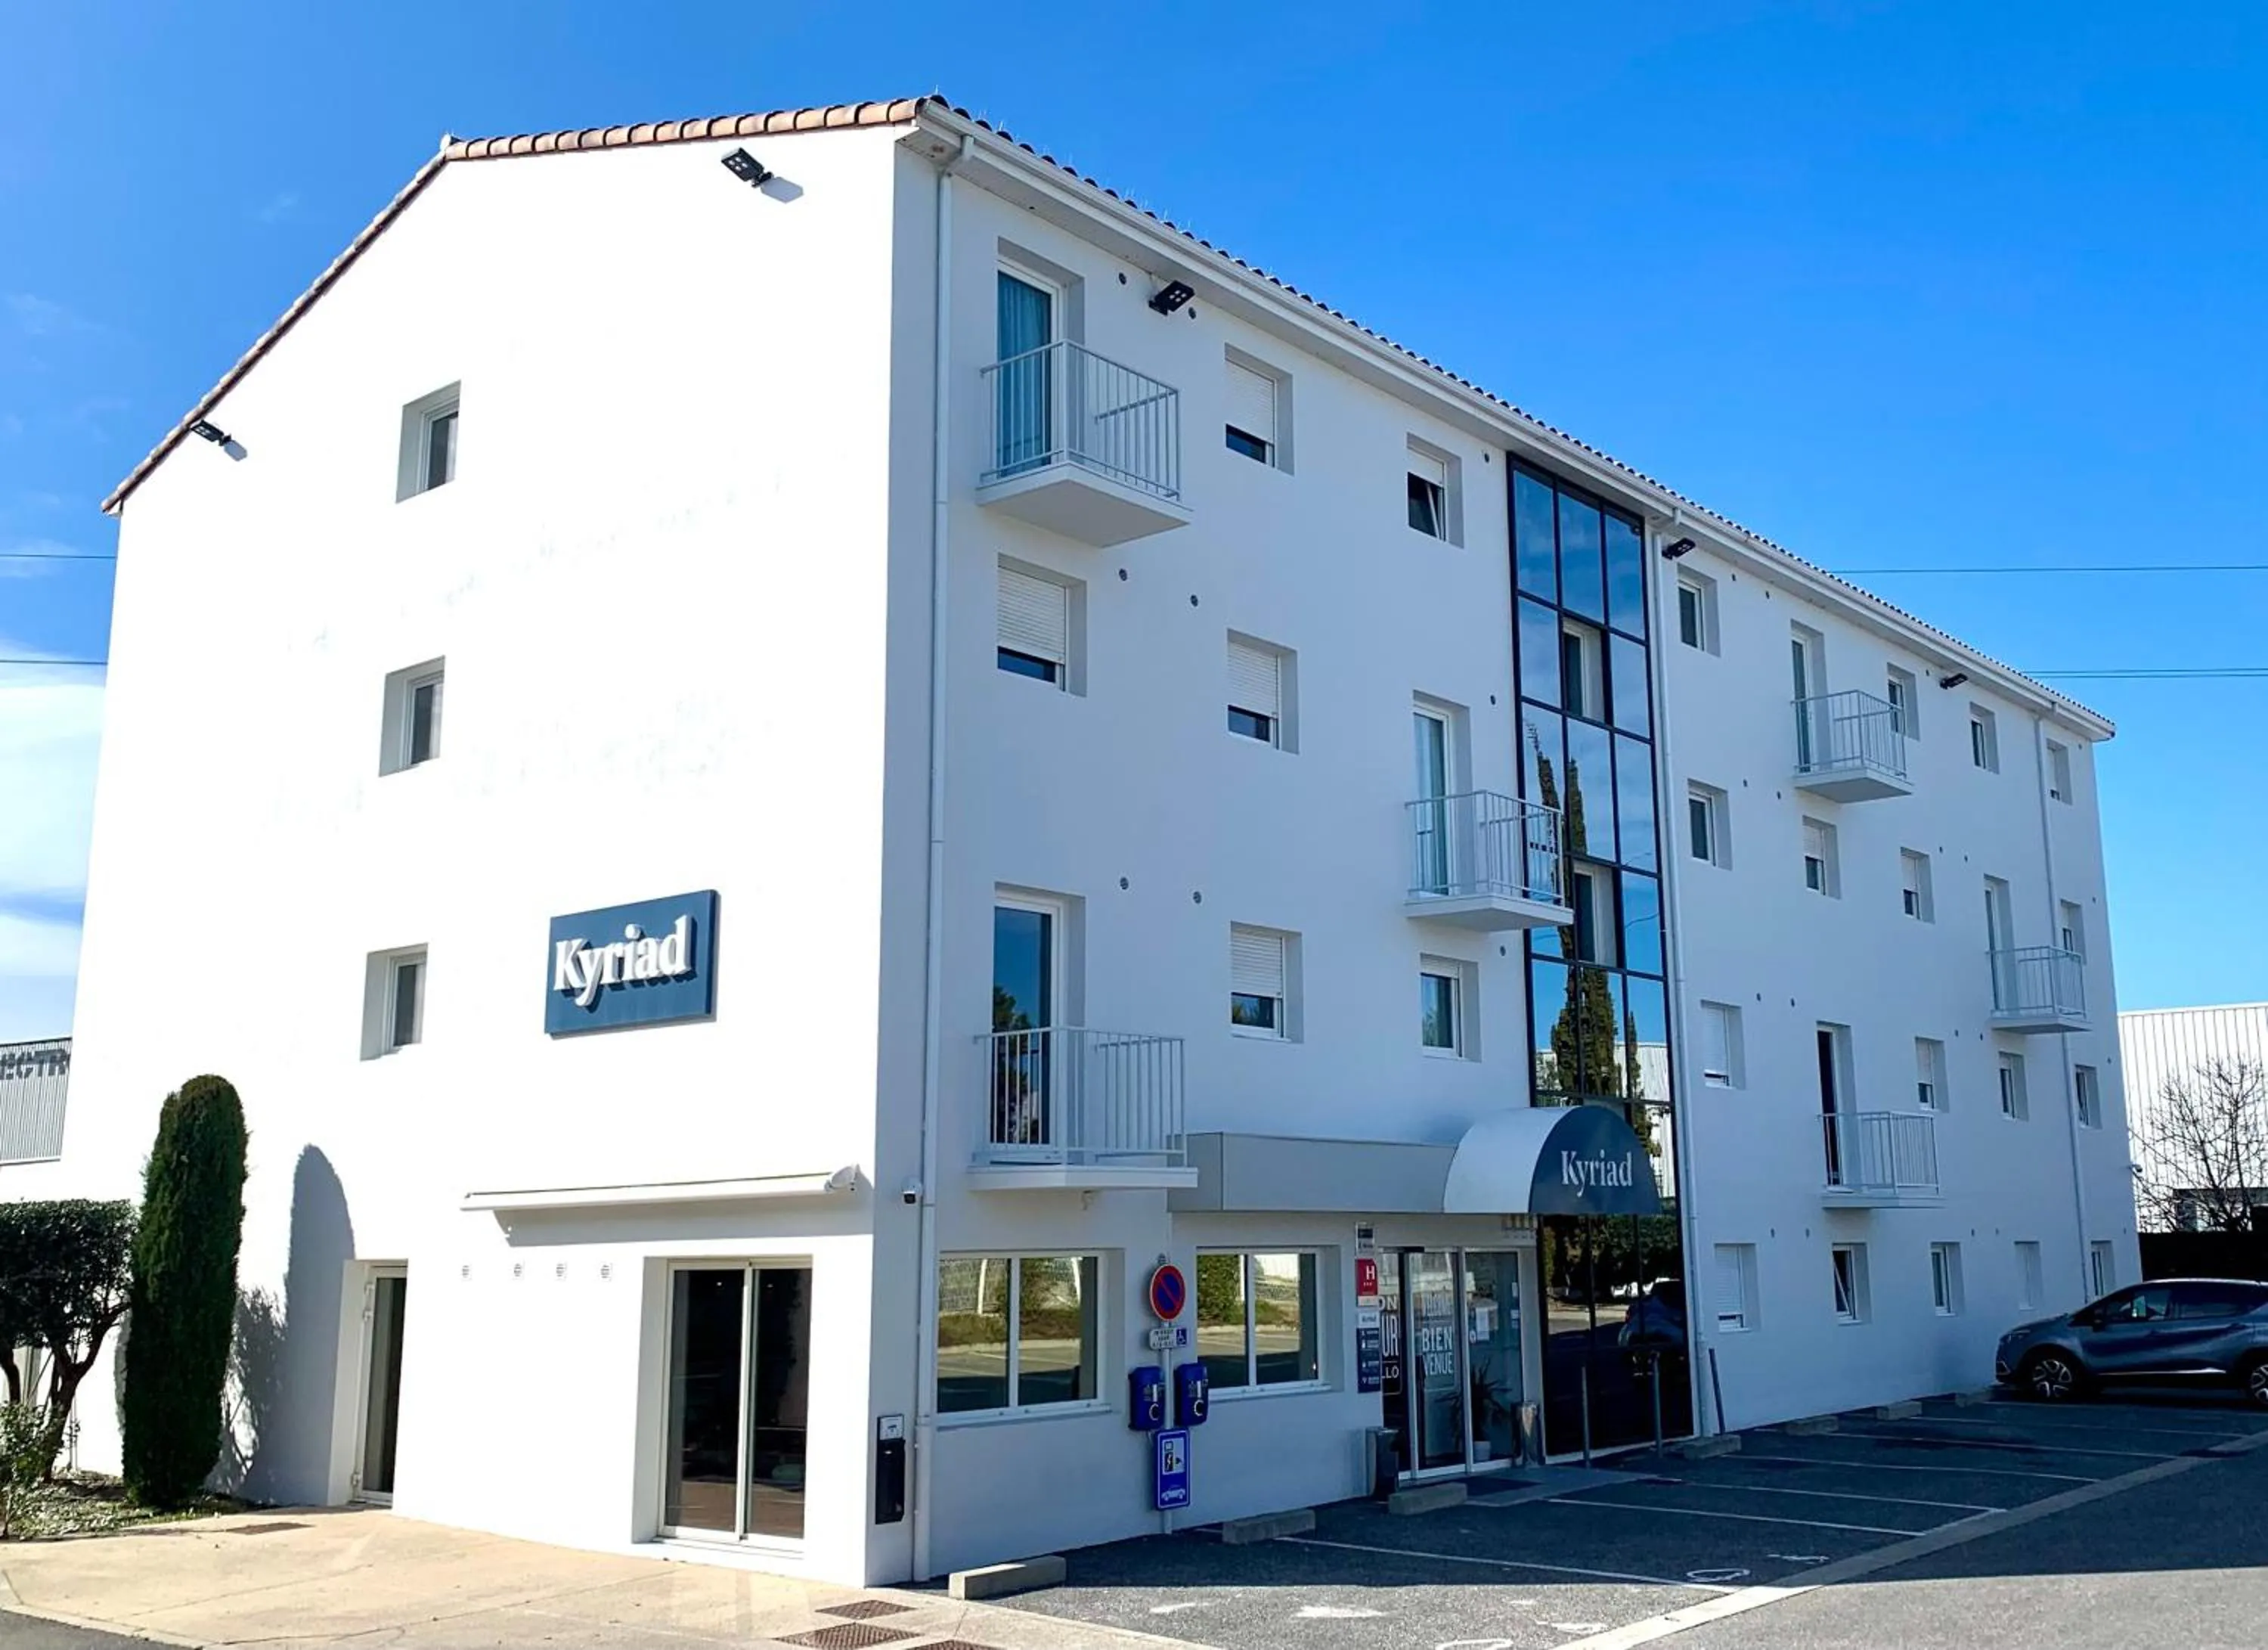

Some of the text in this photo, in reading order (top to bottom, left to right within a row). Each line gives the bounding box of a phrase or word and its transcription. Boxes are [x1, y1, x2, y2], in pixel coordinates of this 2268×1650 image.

[553, 913, 692, 1007] Kyriad
[0, 1049, 70, 1081] ECTR
[1561, 1149, 1633, 1198] Kyriad
[1366, 1265, 1375, 1280] H
[1381, 1313, 1399, 1357] UR
[1422, 1326, 1452, 1352] BIEN
